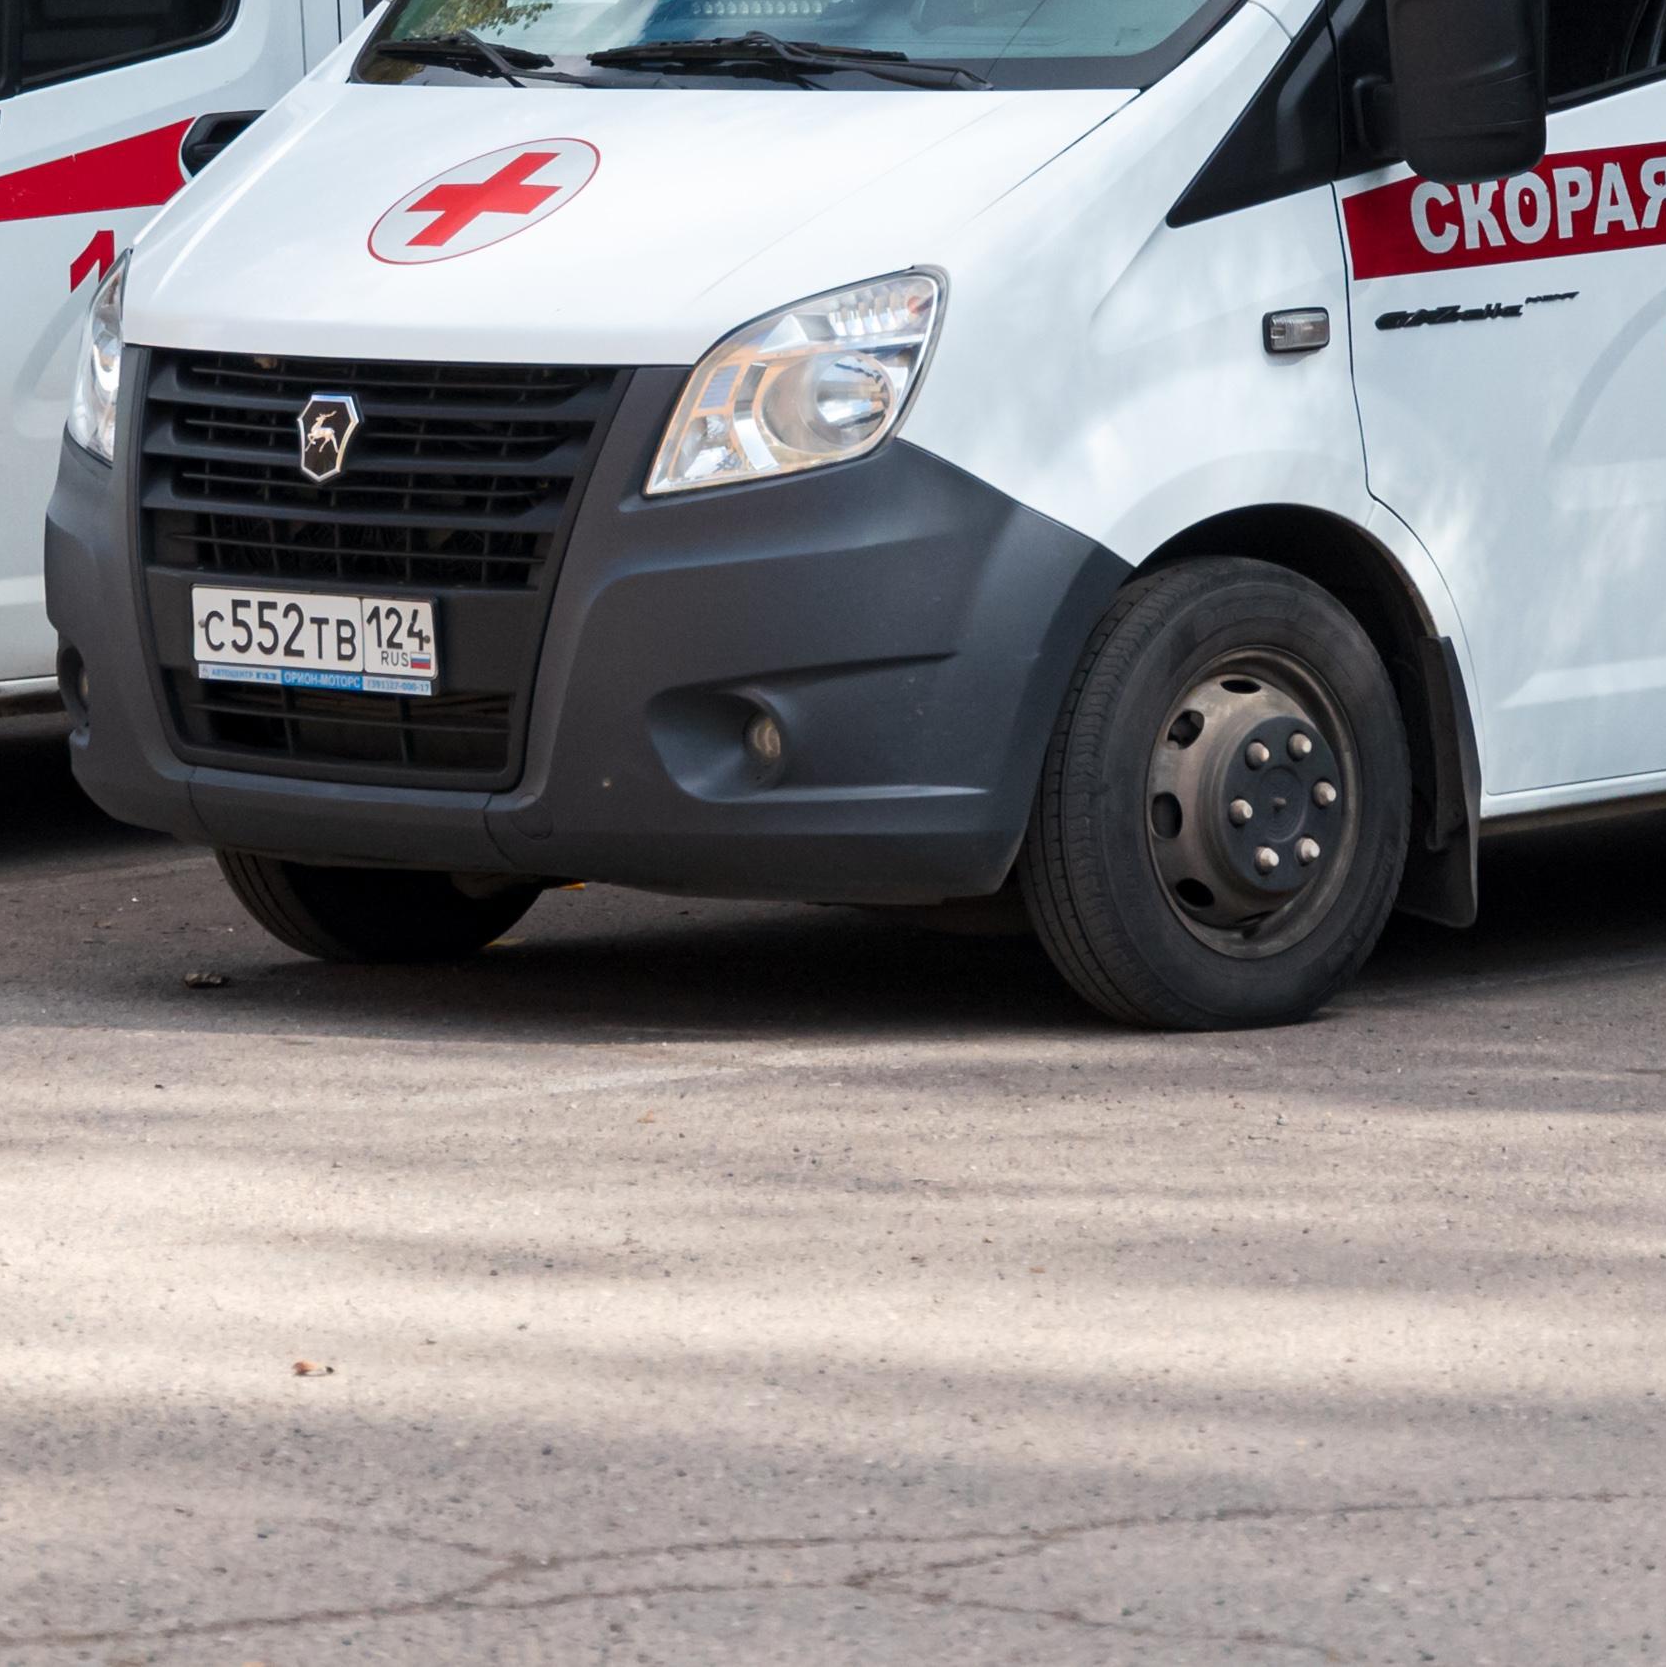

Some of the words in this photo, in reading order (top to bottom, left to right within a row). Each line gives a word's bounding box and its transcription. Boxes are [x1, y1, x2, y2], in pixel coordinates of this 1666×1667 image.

[366, 605, 425, 651] 124
[381, 650, 409, 667] RUS
[284, 670, 361, 689] ОРИОН-МОТОРС
